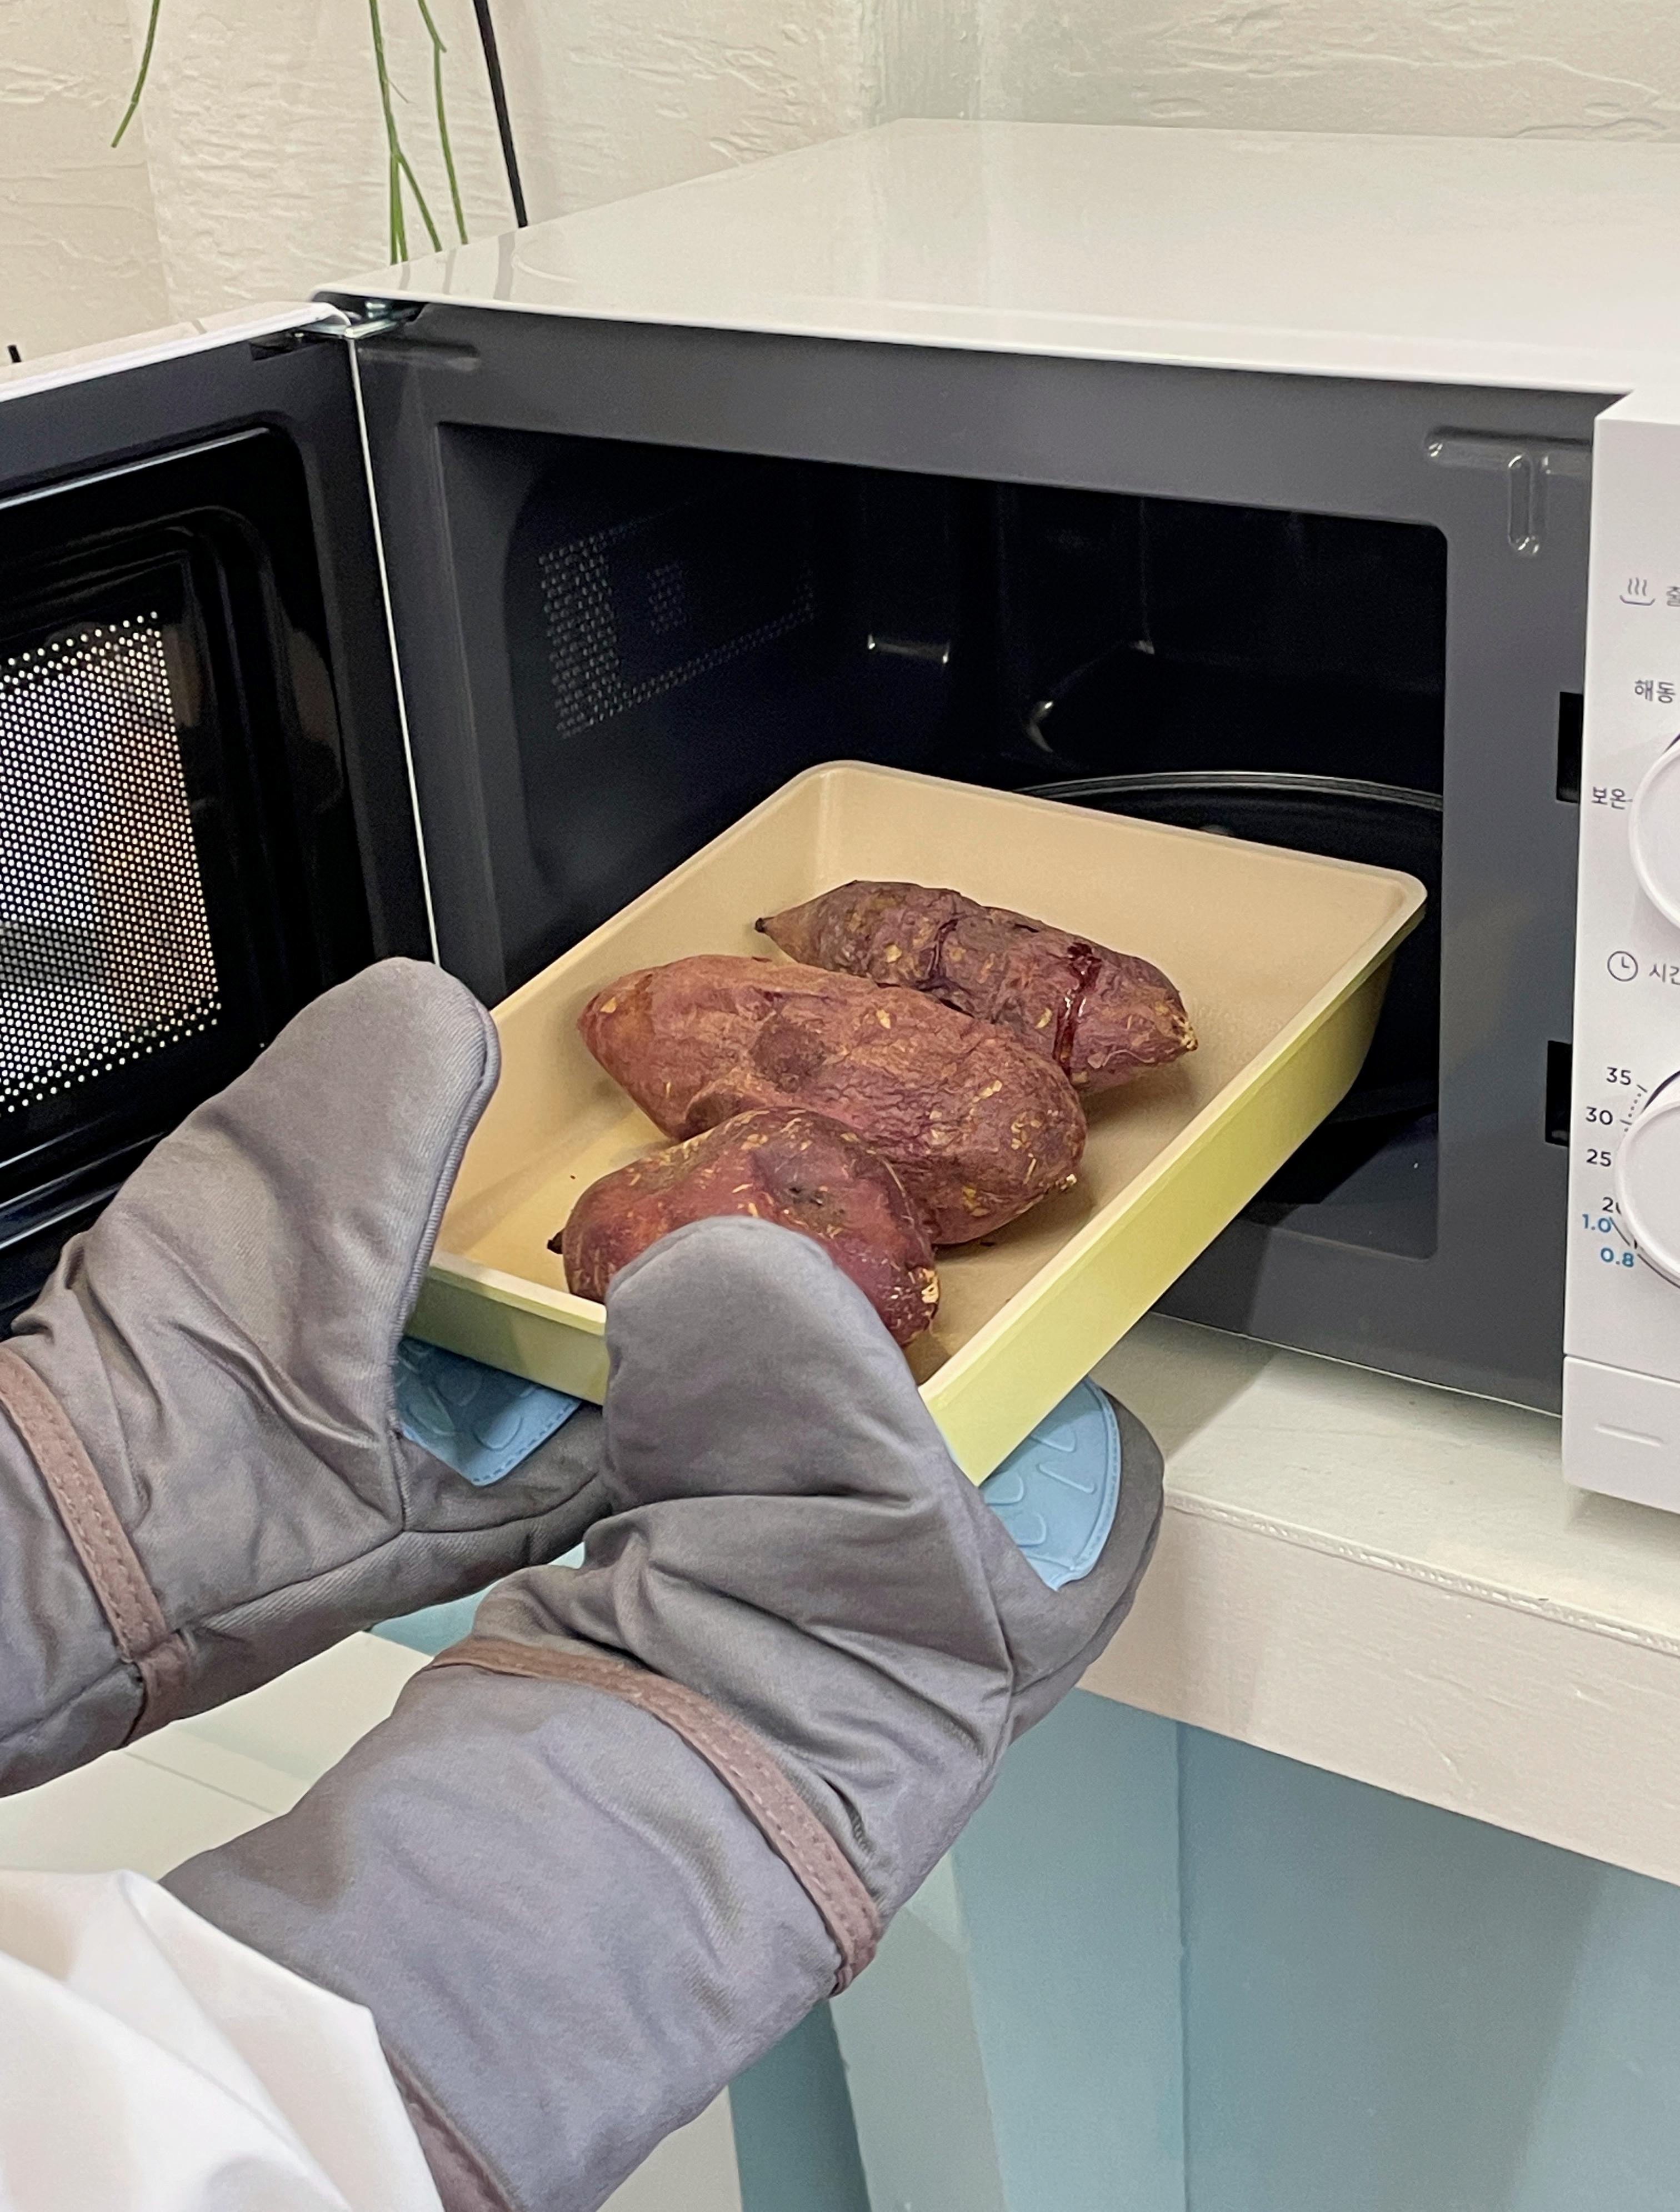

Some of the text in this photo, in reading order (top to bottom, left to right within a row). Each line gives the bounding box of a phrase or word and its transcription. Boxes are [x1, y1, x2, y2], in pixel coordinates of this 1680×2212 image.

[1634, 679, 1676, 704] 해동
[1591, 787, 1626, 810] 보온
[1606, 1067, 1631, 1085] 35
[1586, 1106, 1613, 1125] 30
[1586, 1148, 1611, 1167] 25
[1582, 1214, 1612, 1233] 1.0
[1601, 1247, 1634, 1268] 0.8
